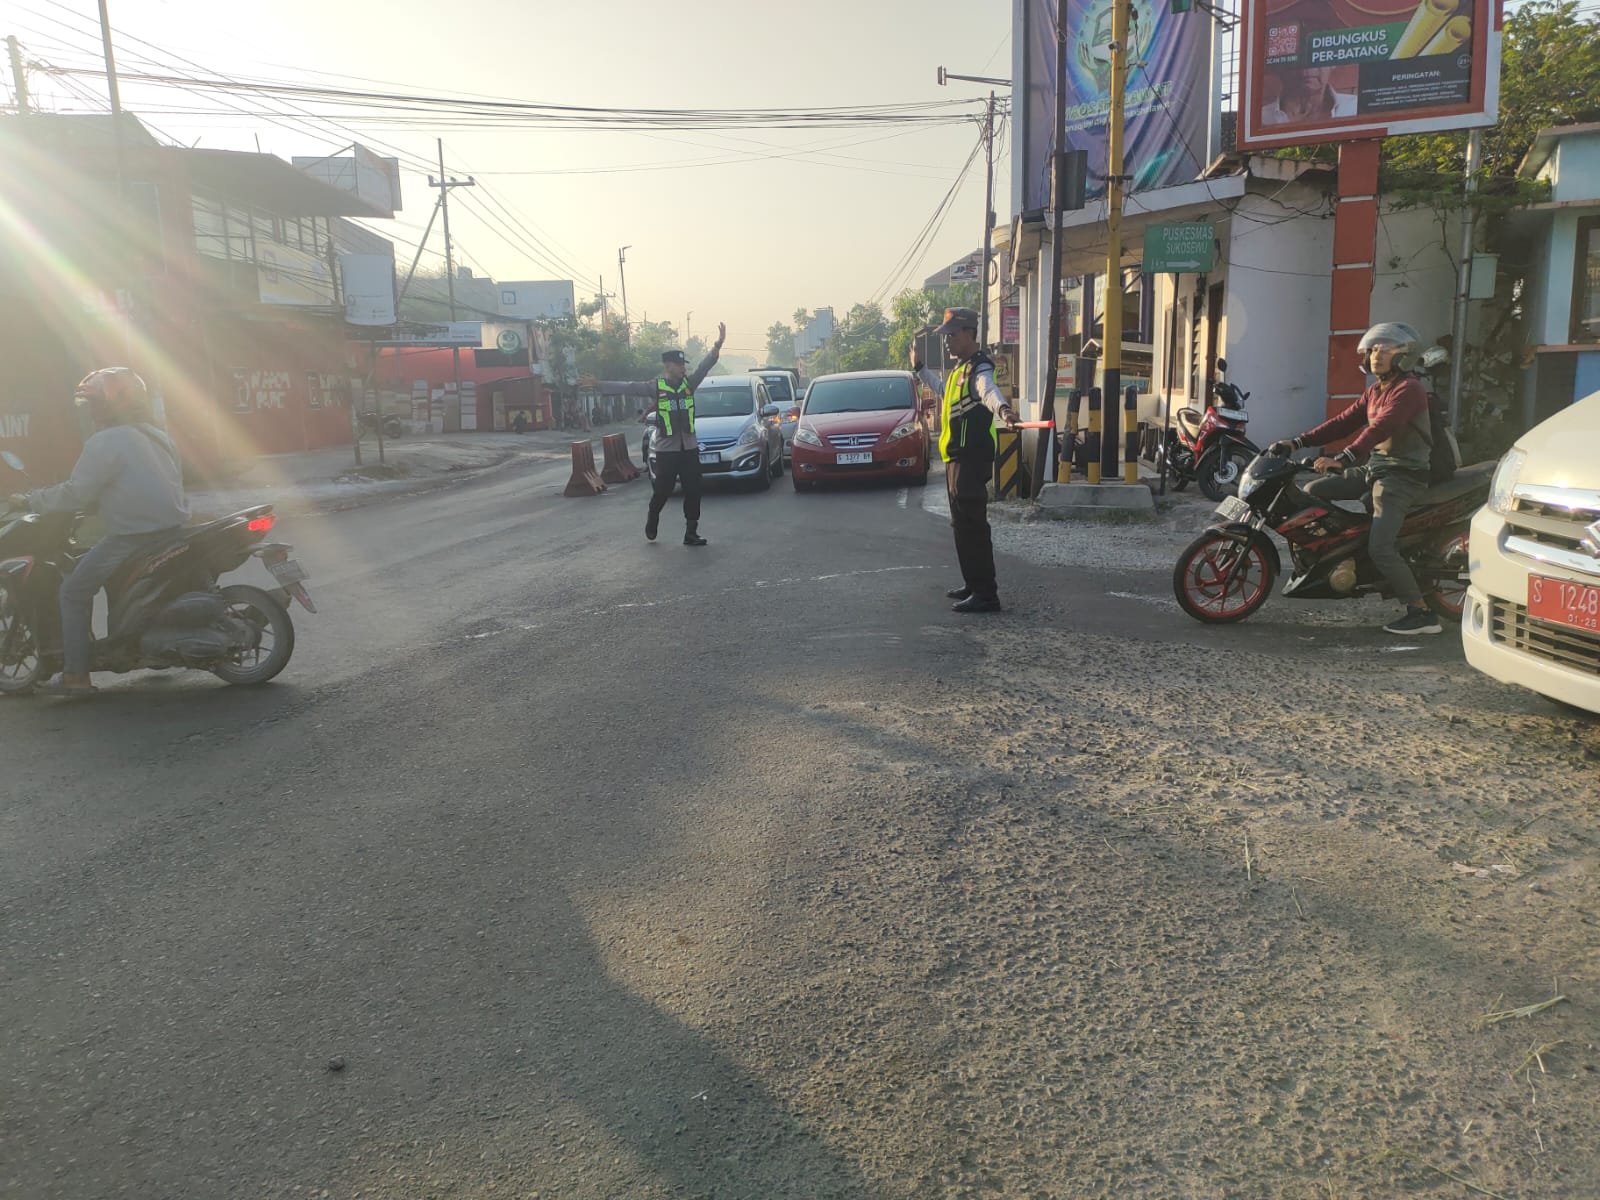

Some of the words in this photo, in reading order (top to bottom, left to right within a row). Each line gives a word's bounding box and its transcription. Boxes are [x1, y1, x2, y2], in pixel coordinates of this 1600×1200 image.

[1312, 30, 1386, 48] DIBUNGKUS
[1311, 44, 1389, 63] PER-BATANG
[1162, 226, 1214, 241] PUSKESMAS
[1533, 579, 1543, 603] S
[1559, 583, 1598, 615] 1248
